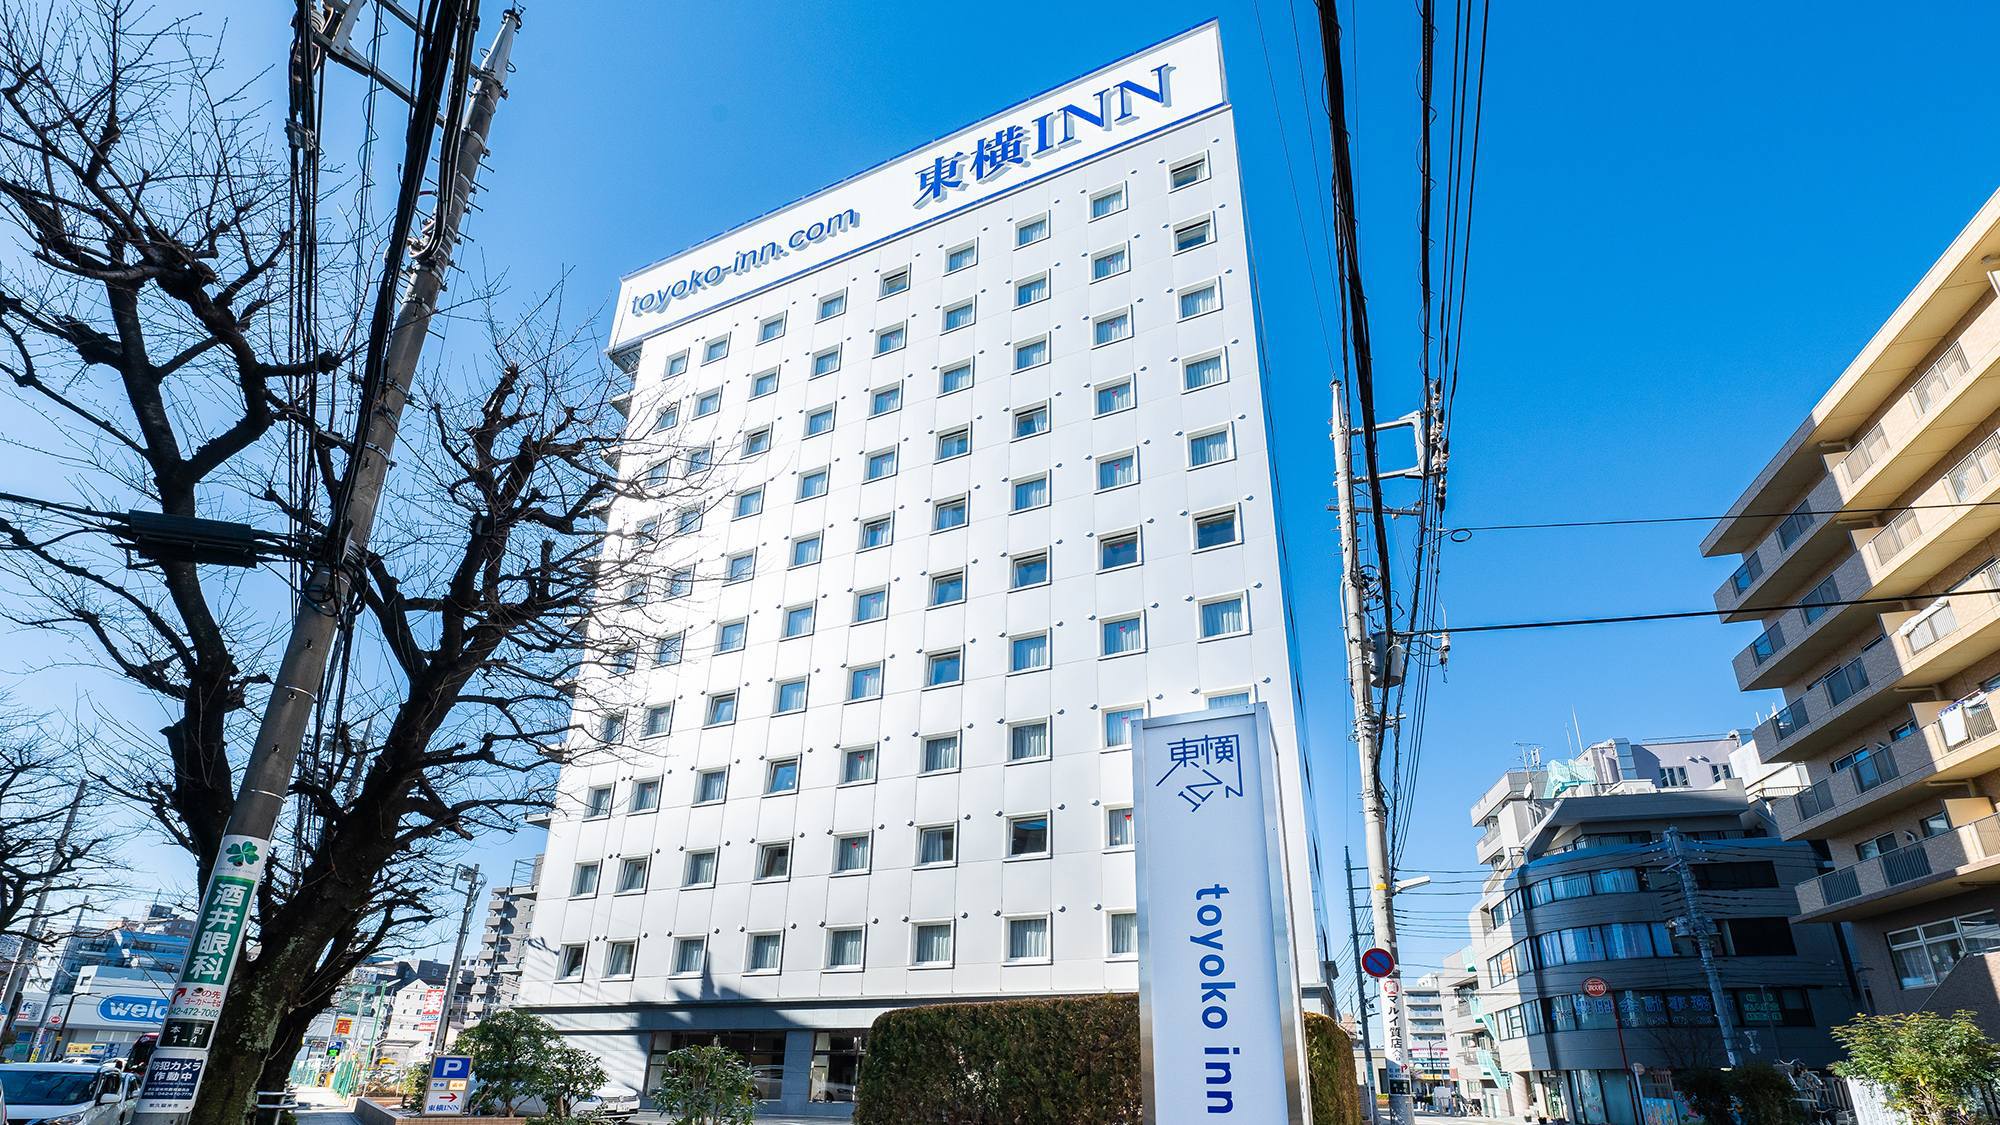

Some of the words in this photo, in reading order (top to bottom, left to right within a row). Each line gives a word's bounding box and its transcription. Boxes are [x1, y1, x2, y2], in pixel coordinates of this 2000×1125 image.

[631, 208, 857, 315] toyoko-inn.com
[190, 883, 248, 980] 酒井眼科
[1189, 883, 1236, 1029] toyoko
[151, 1061, 201, 1071] 防犯カメラ
[154, 1071, 193, 1081] 作動中
[442, 1060, 462, 1076] P
[1203, 1046, 1240, 1114] inn
